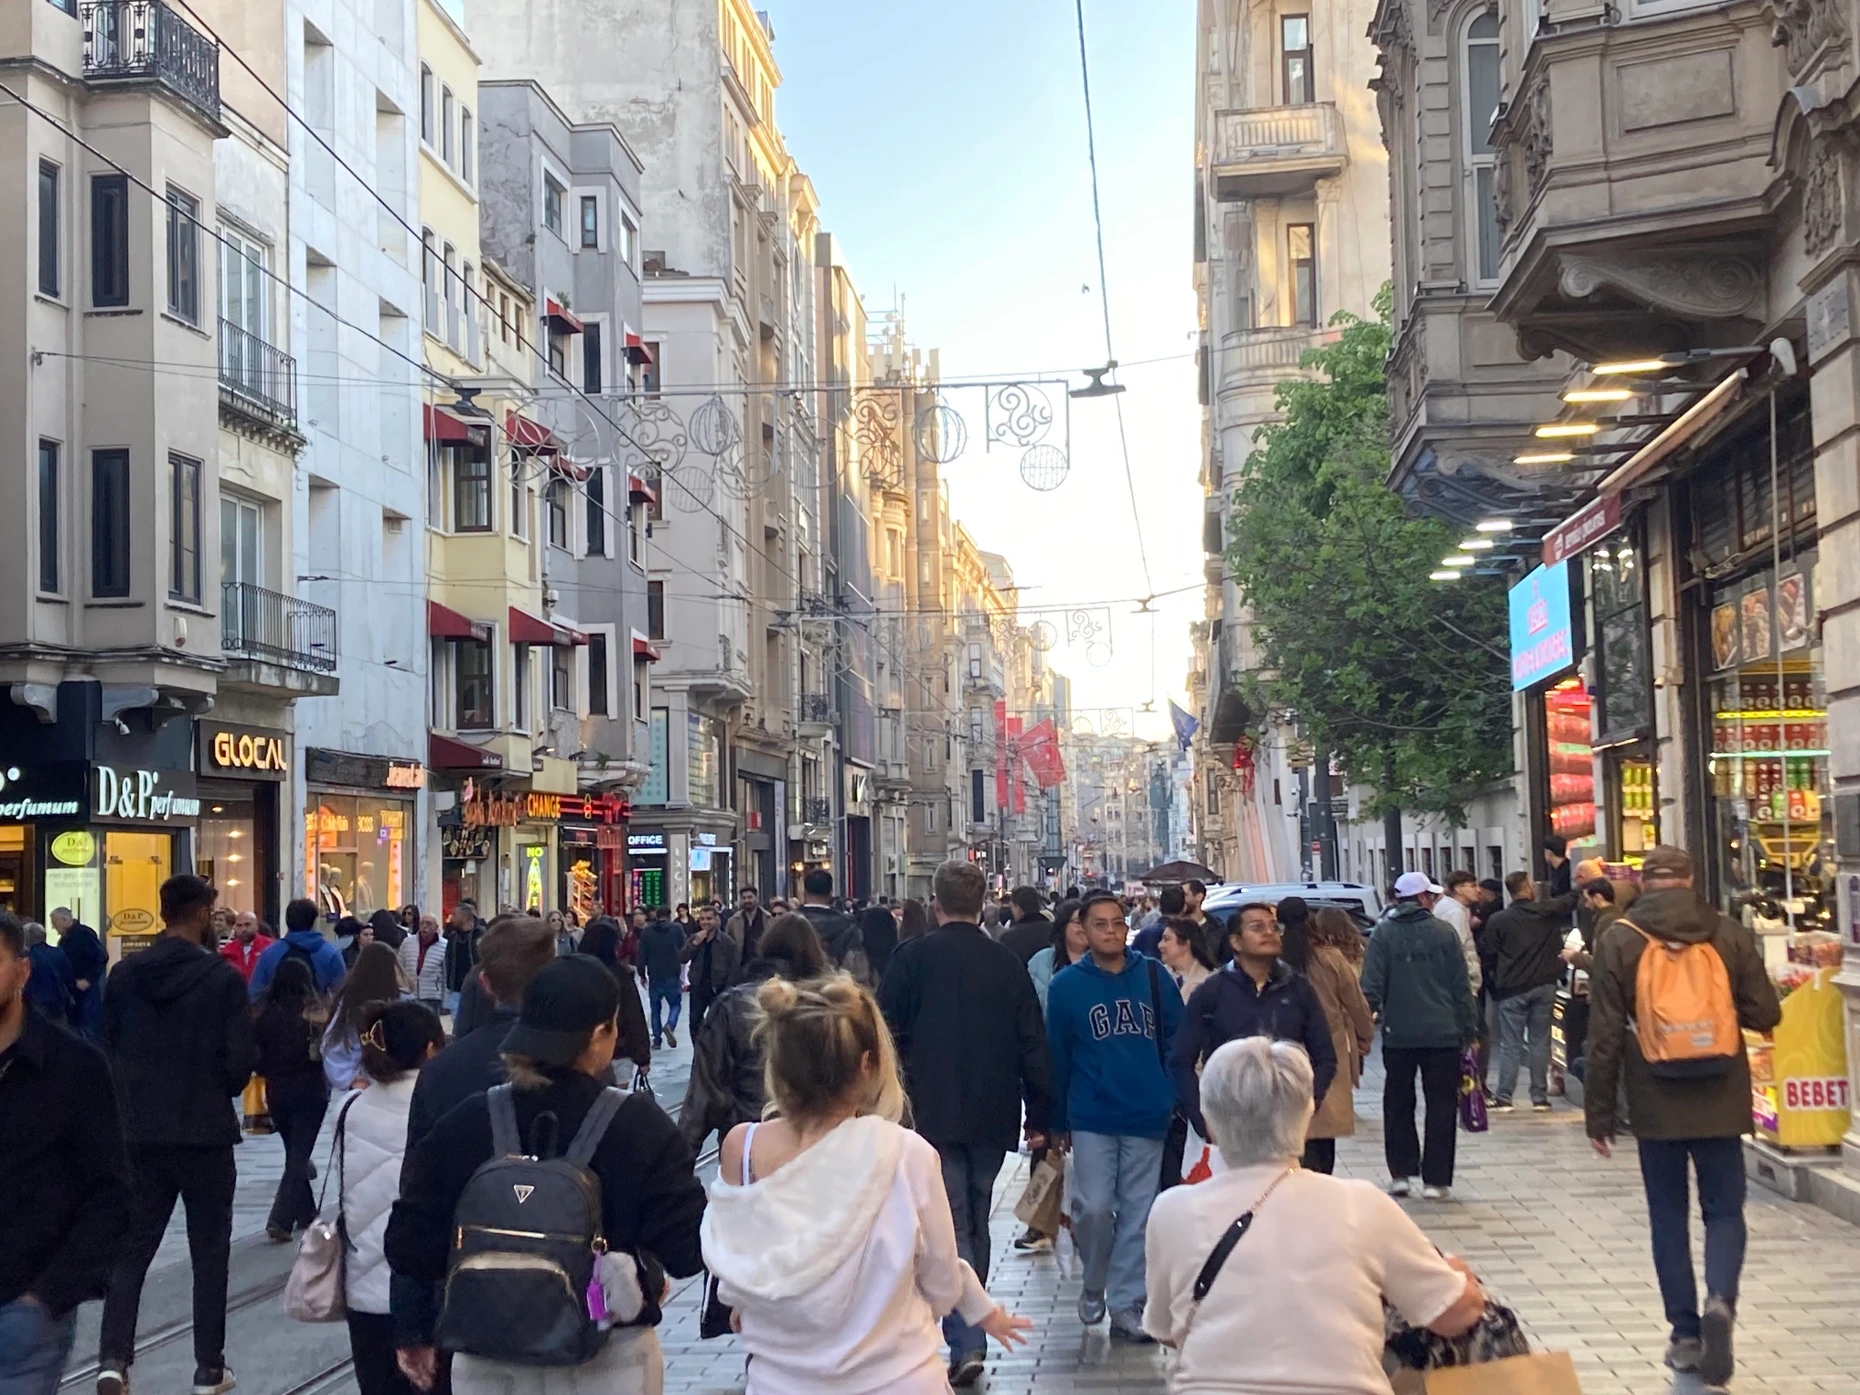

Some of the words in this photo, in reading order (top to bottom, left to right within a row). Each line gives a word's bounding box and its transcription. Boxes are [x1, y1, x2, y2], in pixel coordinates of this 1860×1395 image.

[214, 732, 287, 771] GLOCAL
[527, 793, 561, 819] CHANGE
[627, 835, 663, 845] OFFICE
[526, 847, 544, 858] NO
